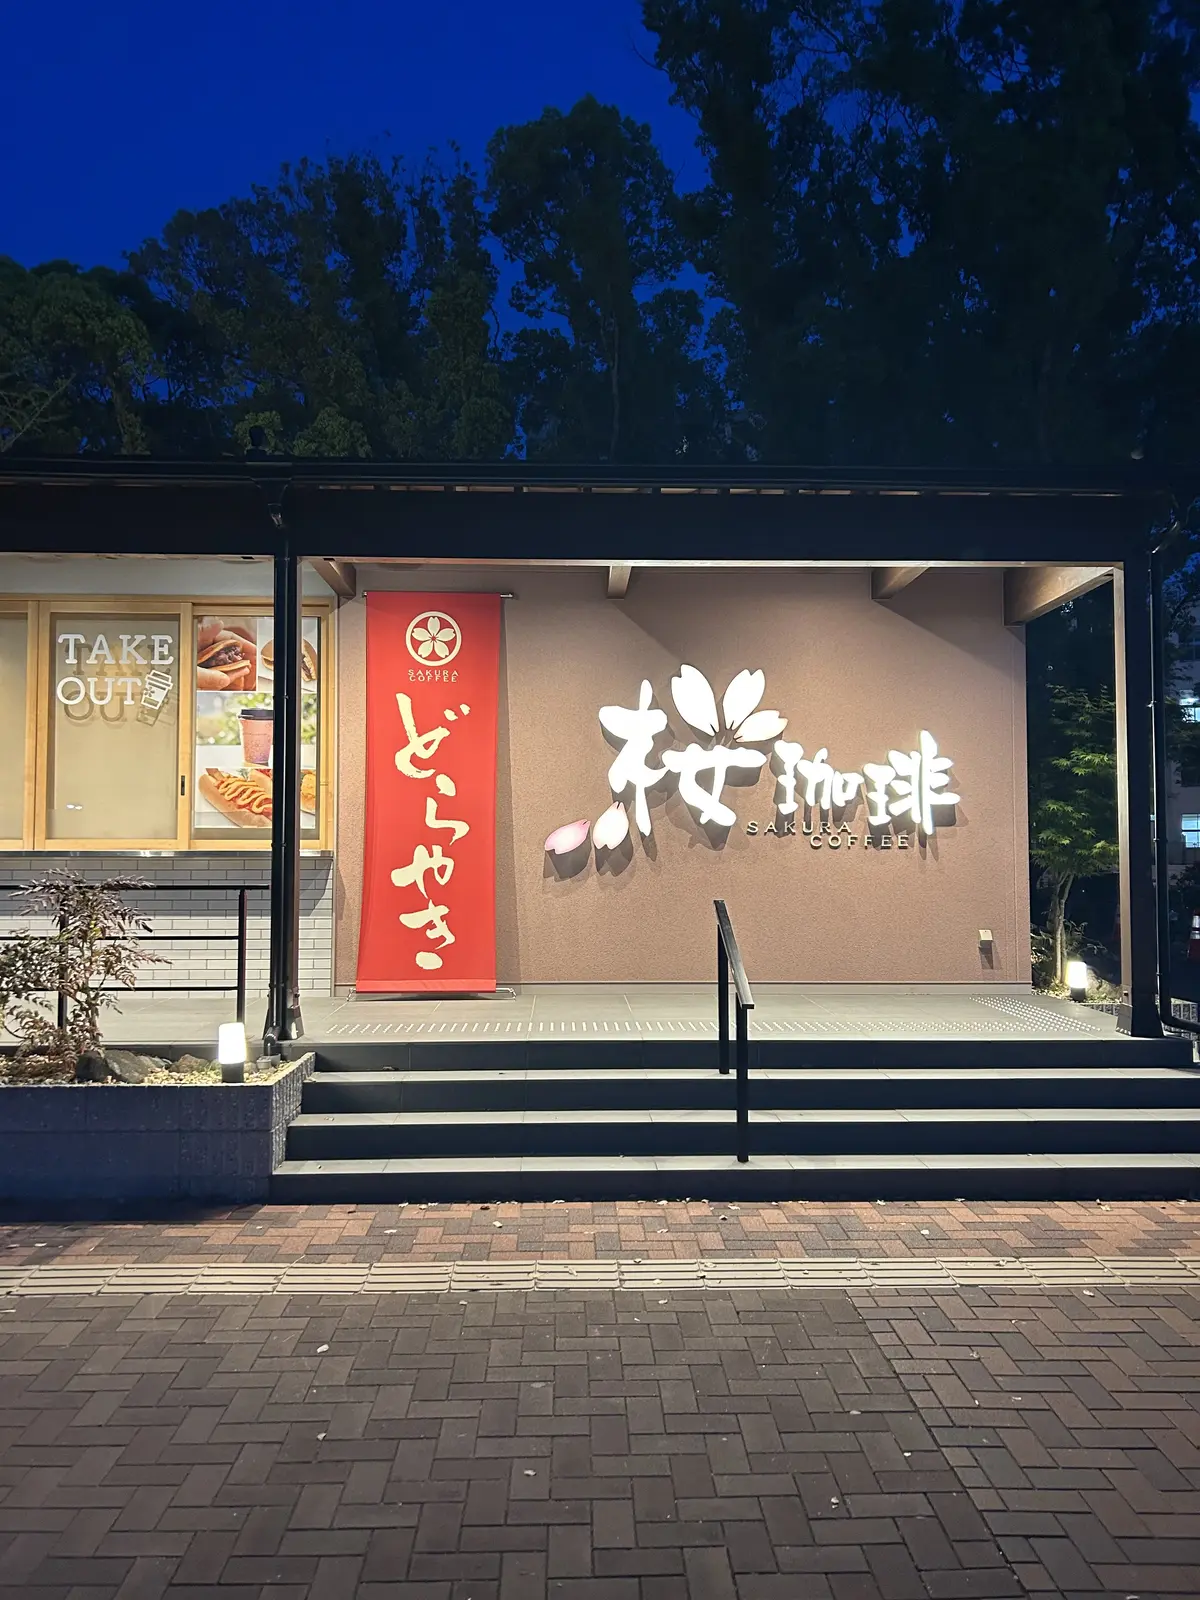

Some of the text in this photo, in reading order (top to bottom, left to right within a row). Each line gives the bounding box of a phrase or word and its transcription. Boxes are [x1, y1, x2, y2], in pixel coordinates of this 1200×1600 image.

[58, 633, 174, 665] TAKE
[56, 676, 142, 706] OUT
[599, 664, 961, 836] 桜珈琲
[390, 692, 470, 970] どらやき
[746, 821, 852, 834] SAKURA
[810, 835, 909, 848] COFFEE
